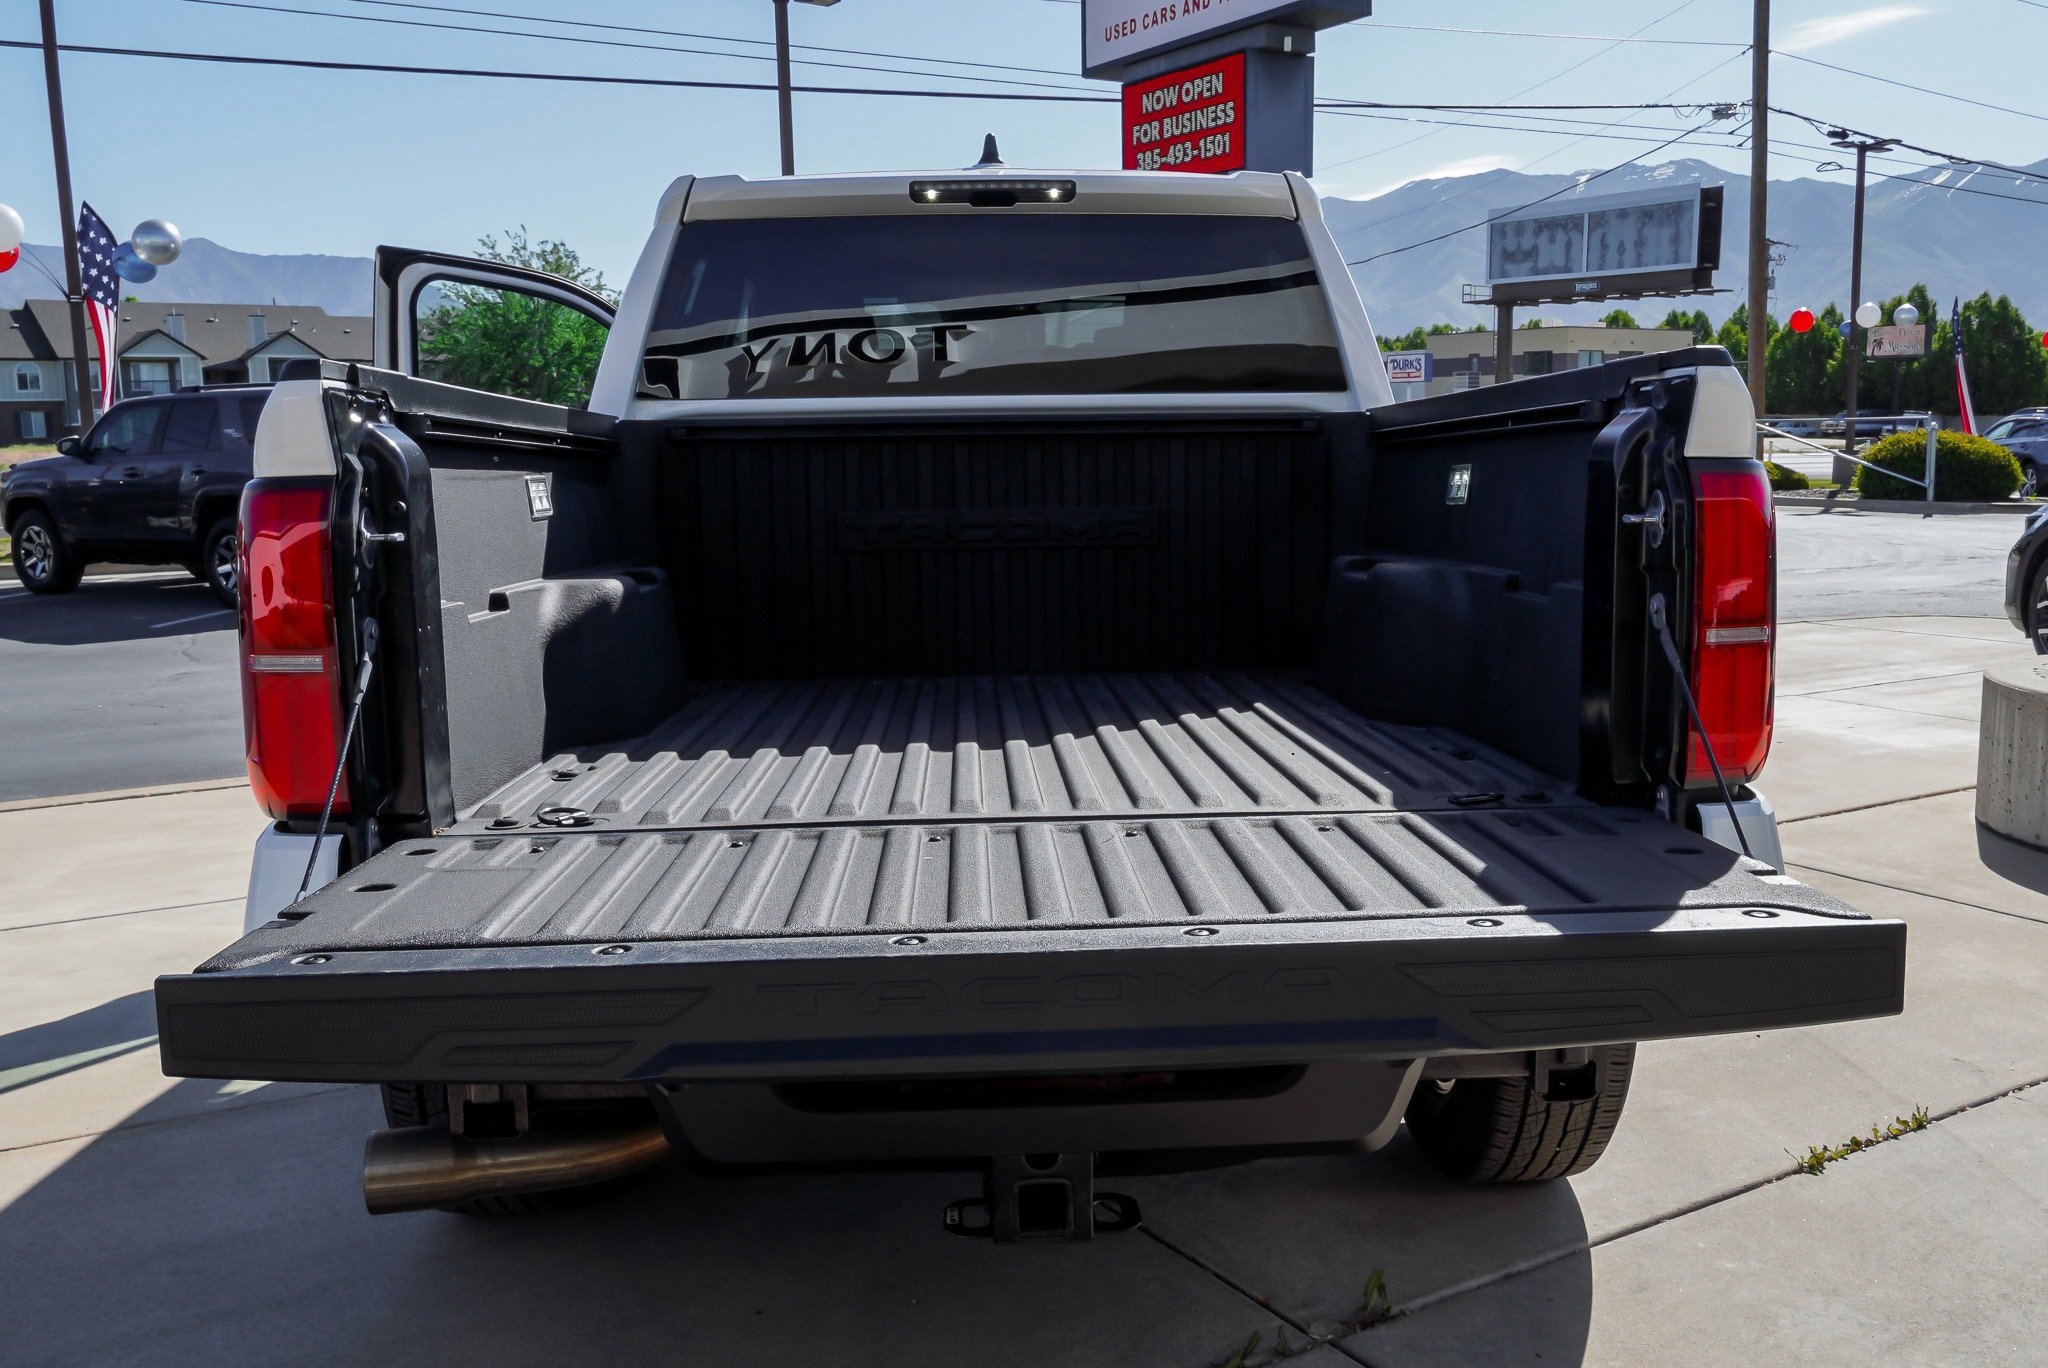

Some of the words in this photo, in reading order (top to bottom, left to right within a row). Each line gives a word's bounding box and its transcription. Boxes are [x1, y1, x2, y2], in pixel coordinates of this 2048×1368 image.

[1104, 18, 1137, 42] USED
[1142, 3, 1177, 30] CARS
[1182, 0, 1210, 17] AND
[1142, 84, 1179, 114] NOW
[1182, 73, 1223, 103] OPEN
[1132, 121, 1160, 146] FOR
[1163, 101, 1235, 139] BUSINESS
[1136, 132, 1230, 170] 385-493-1501
[1389, 358, 1422, 371] DURK'S
[845, 516, 1155, 546] TACOMA
[756, 967, 1349, 1016] TACOMA
